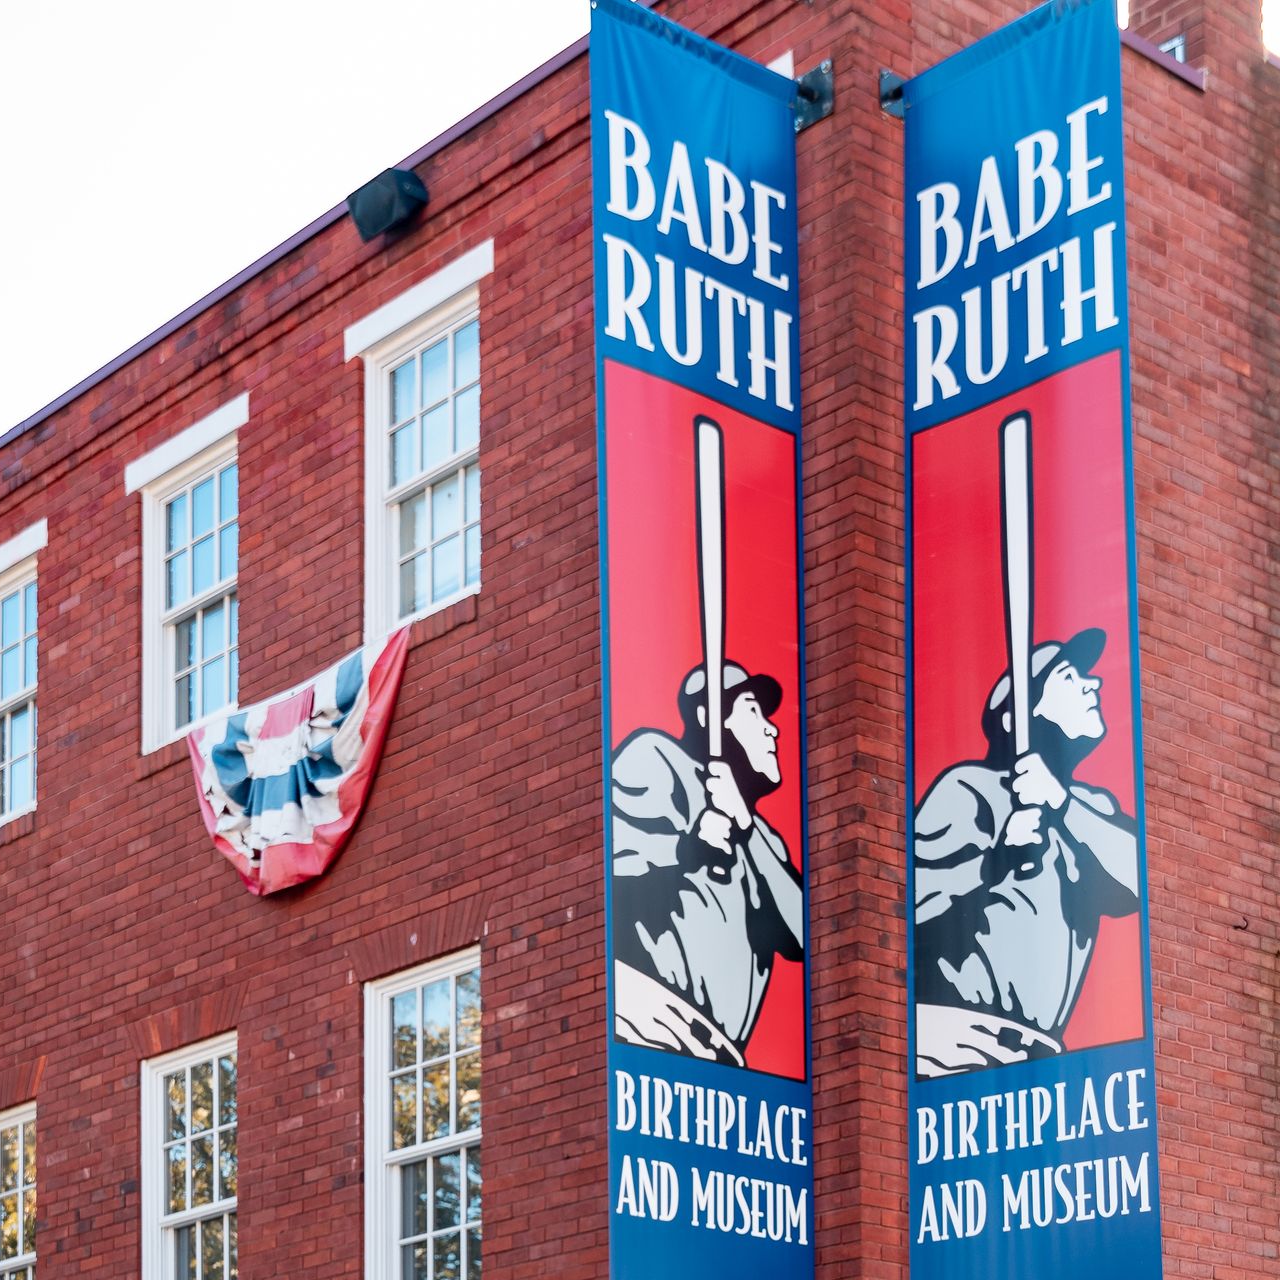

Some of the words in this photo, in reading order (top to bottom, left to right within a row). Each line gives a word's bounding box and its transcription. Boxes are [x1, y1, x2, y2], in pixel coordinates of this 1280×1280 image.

[605, 109, 789, 291] BABE
[916, 97, 1112, 290] BABE
[602, 232, 794, 412] RUTH
[913, 221, 1119, 411] RUTH
[616, 1070, 808, 1166] BIRTHPLACE
[916, 1068, 1149, 1165] BIRTHPLACE
[616, 1154, 680, 1223] AND
[691, 1167, 809, 1246] MUSEUM
[917, 1179, 987, 1245] AND
[1002, 1153, 1152, 1233] MUSEUM
